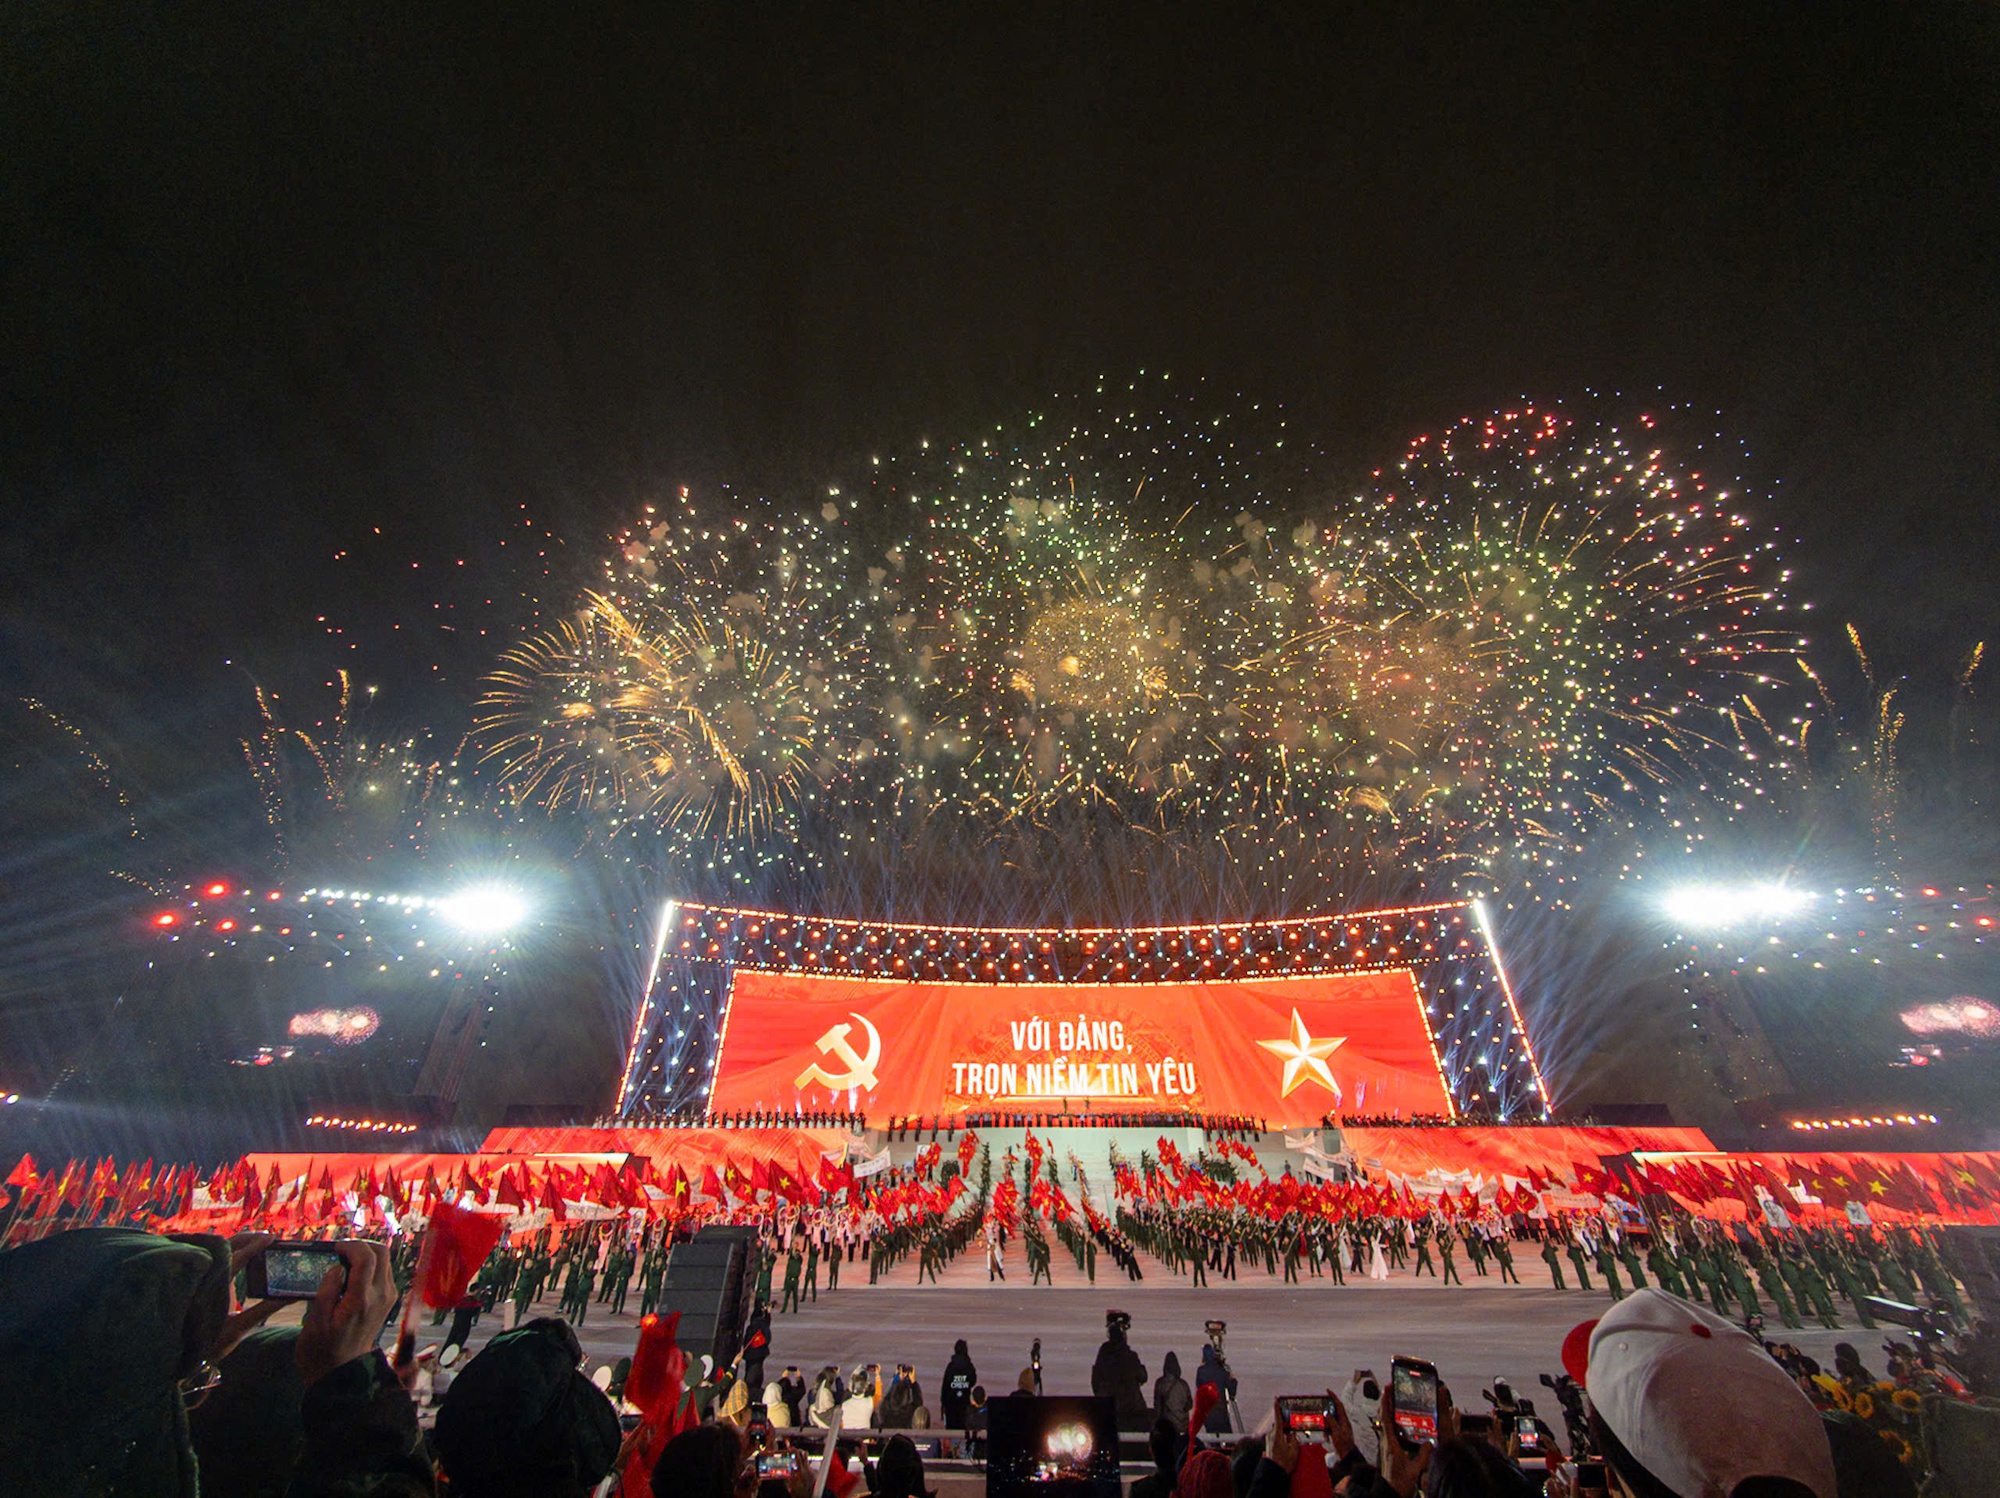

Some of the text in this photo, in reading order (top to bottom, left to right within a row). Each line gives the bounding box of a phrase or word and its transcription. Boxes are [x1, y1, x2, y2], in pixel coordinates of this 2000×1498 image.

[1010, 1014, 1133, 1055] VỚI ĐẢNG,
[951, 1055, 1197, 1100] TRỌN NIỀM TIN YÊU
